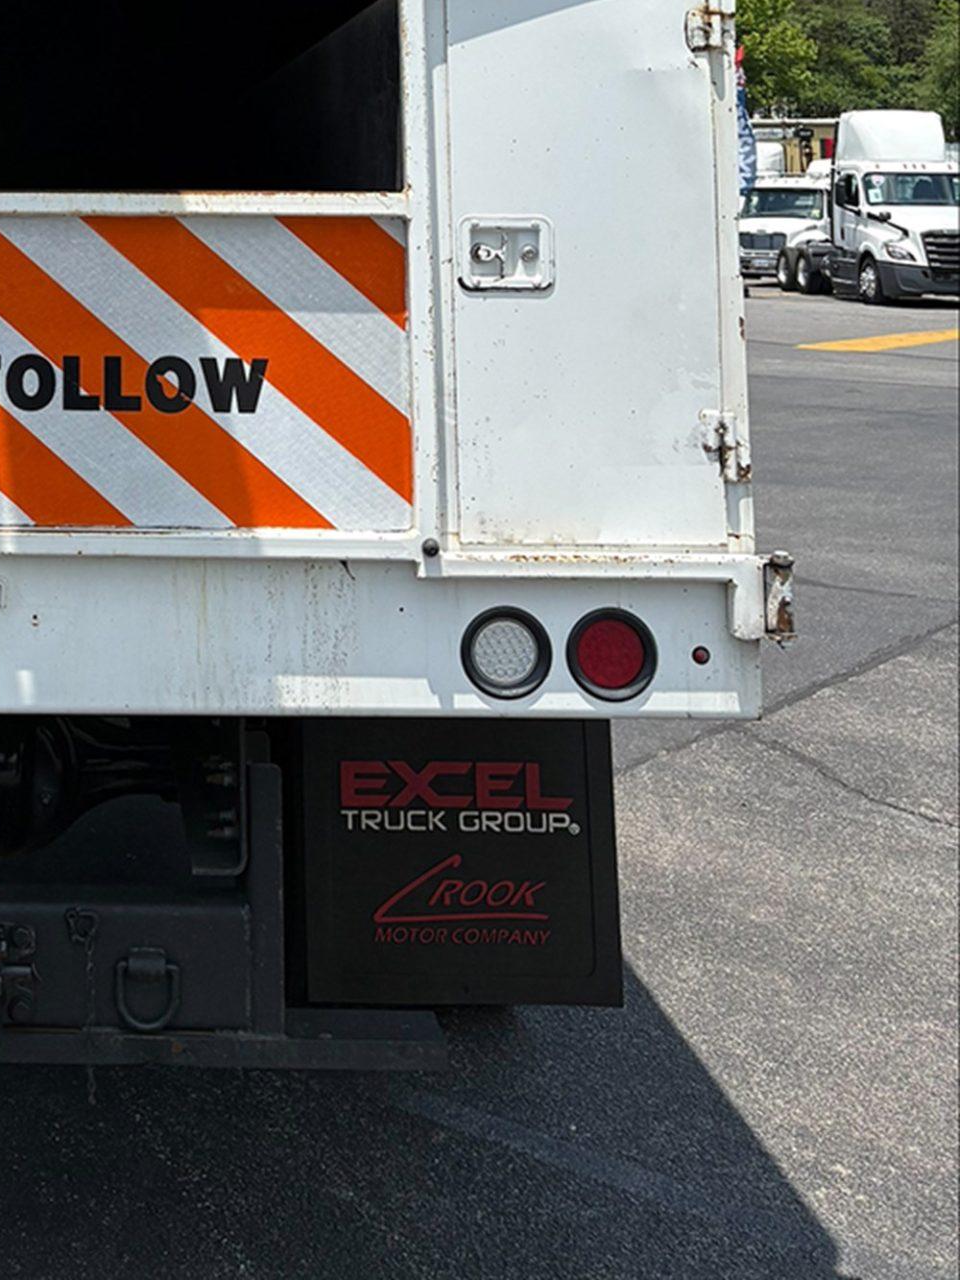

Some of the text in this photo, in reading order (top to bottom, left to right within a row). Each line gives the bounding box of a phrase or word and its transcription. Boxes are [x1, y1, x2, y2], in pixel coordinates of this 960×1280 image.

[340, 760, 574, 810] EXCEL
[340, 810, 447, 832] TRUCK
[374, 927, 551, 945] MOTOR COMPANY
